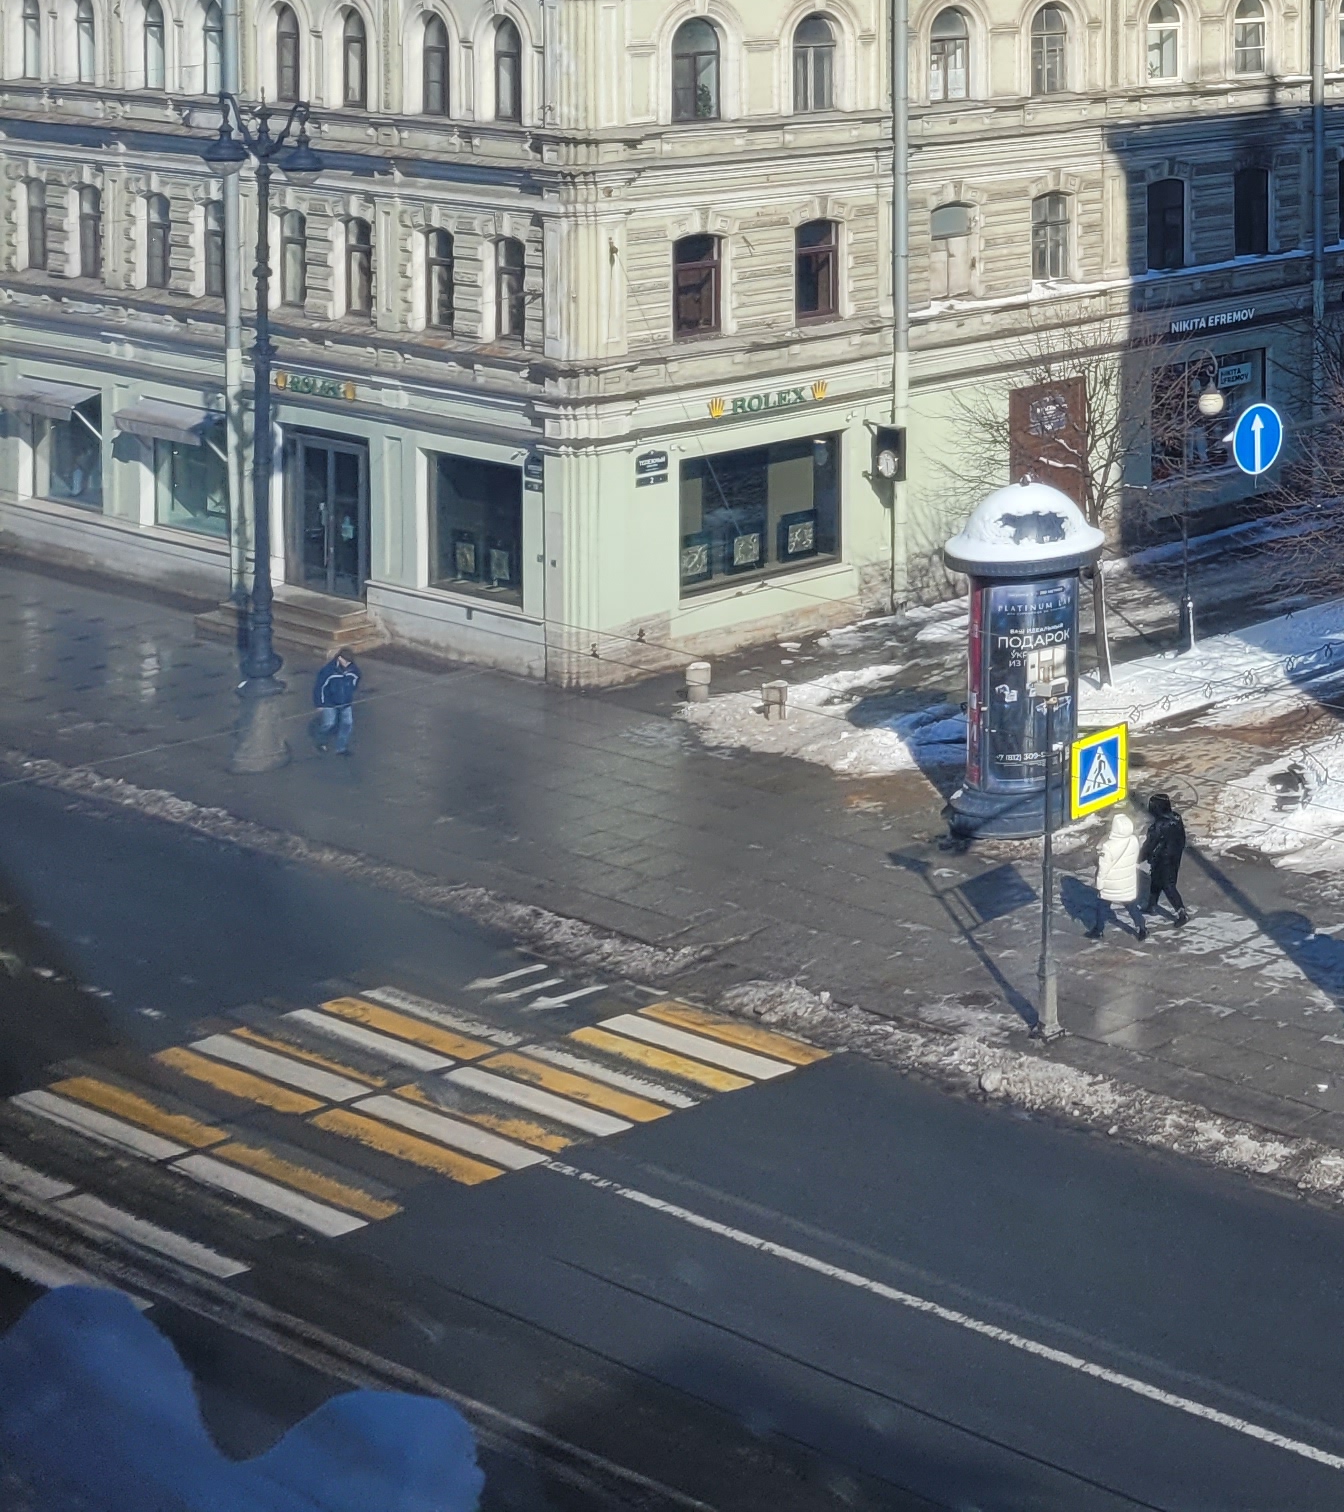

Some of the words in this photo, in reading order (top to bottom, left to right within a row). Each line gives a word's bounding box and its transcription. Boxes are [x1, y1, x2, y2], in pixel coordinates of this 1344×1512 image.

[1171, 317, 1206, 333] NIKITA
[1208, 308, 1255, 327] EFREMOV
[731, 387, 807, 415] ROLEX
[998, 601, 1053, 612] PLATINUM
[998, 628, 1070, 650] ПОДАРОК
